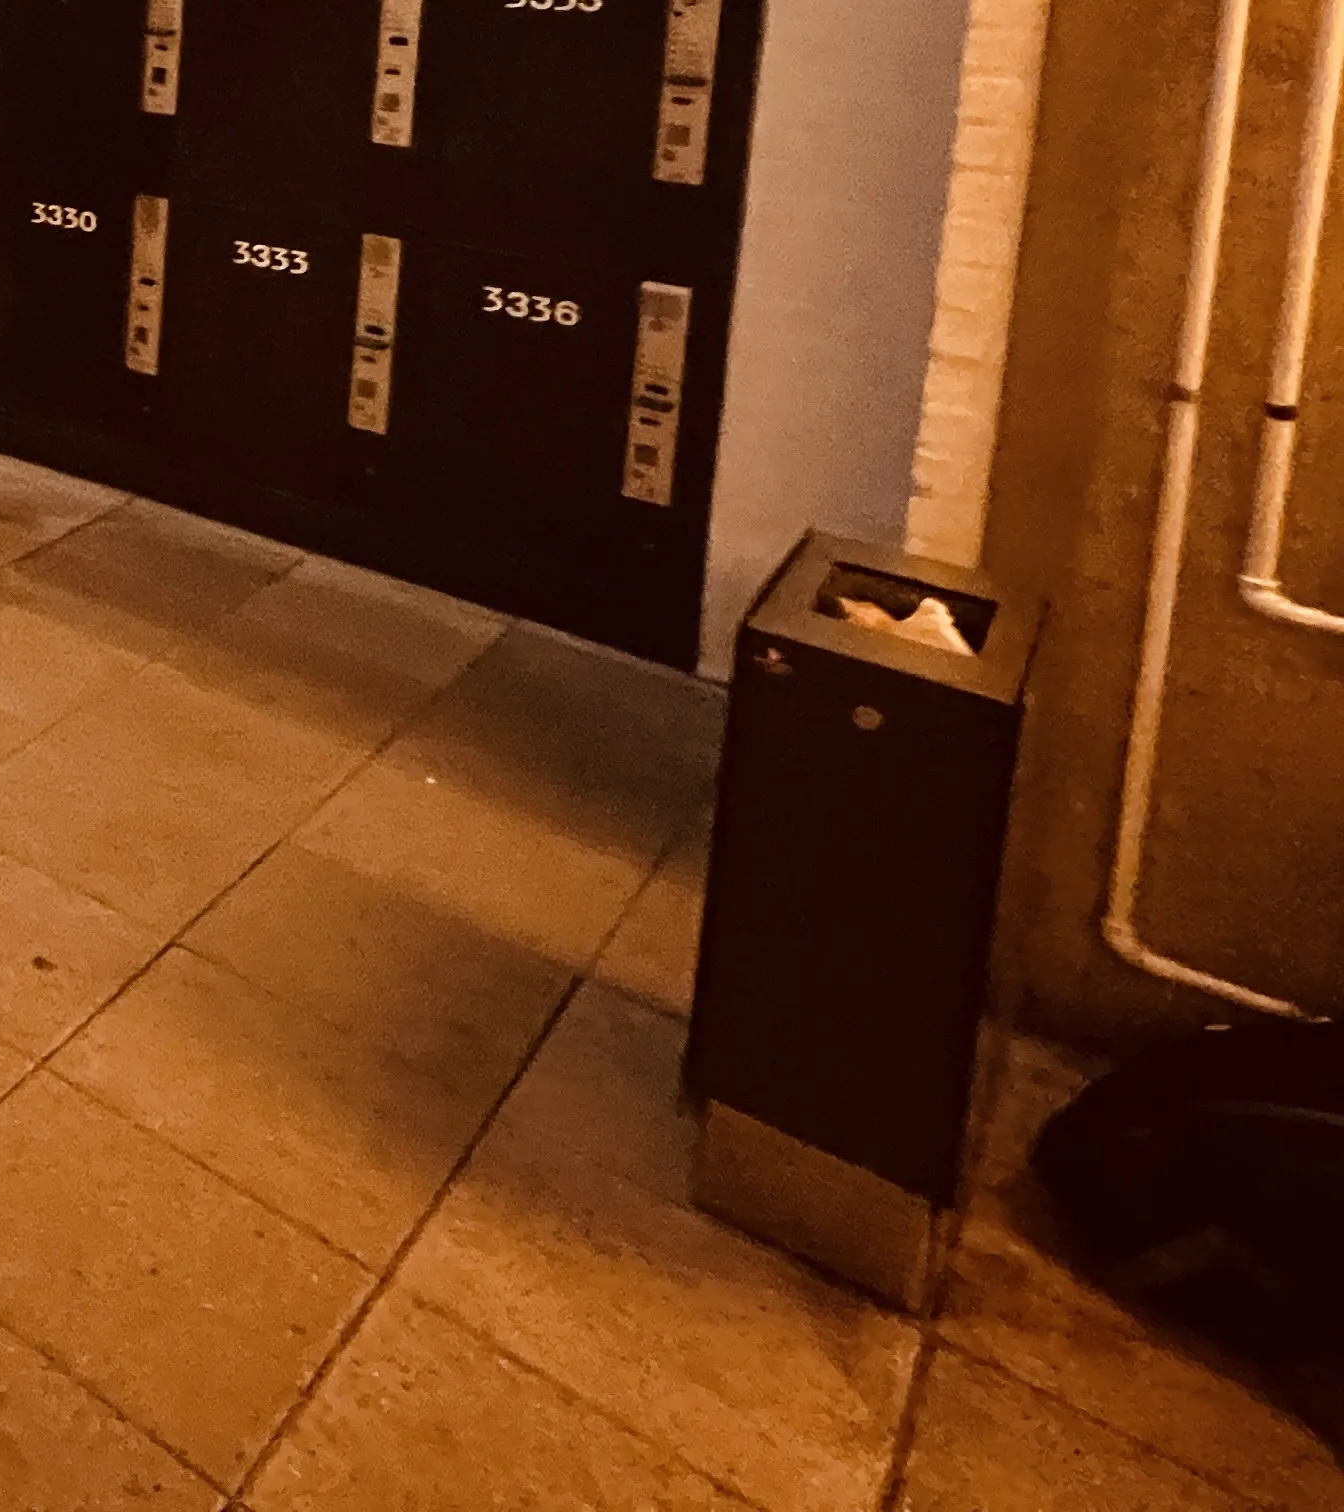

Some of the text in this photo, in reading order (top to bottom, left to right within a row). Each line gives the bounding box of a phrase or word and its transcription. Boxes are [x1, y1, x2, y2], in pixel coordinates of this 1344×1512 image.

[30, 202, 97, 233] 3330
[233, 240, 309, 275] 3333
[483, 286, 579, 326] 3336
